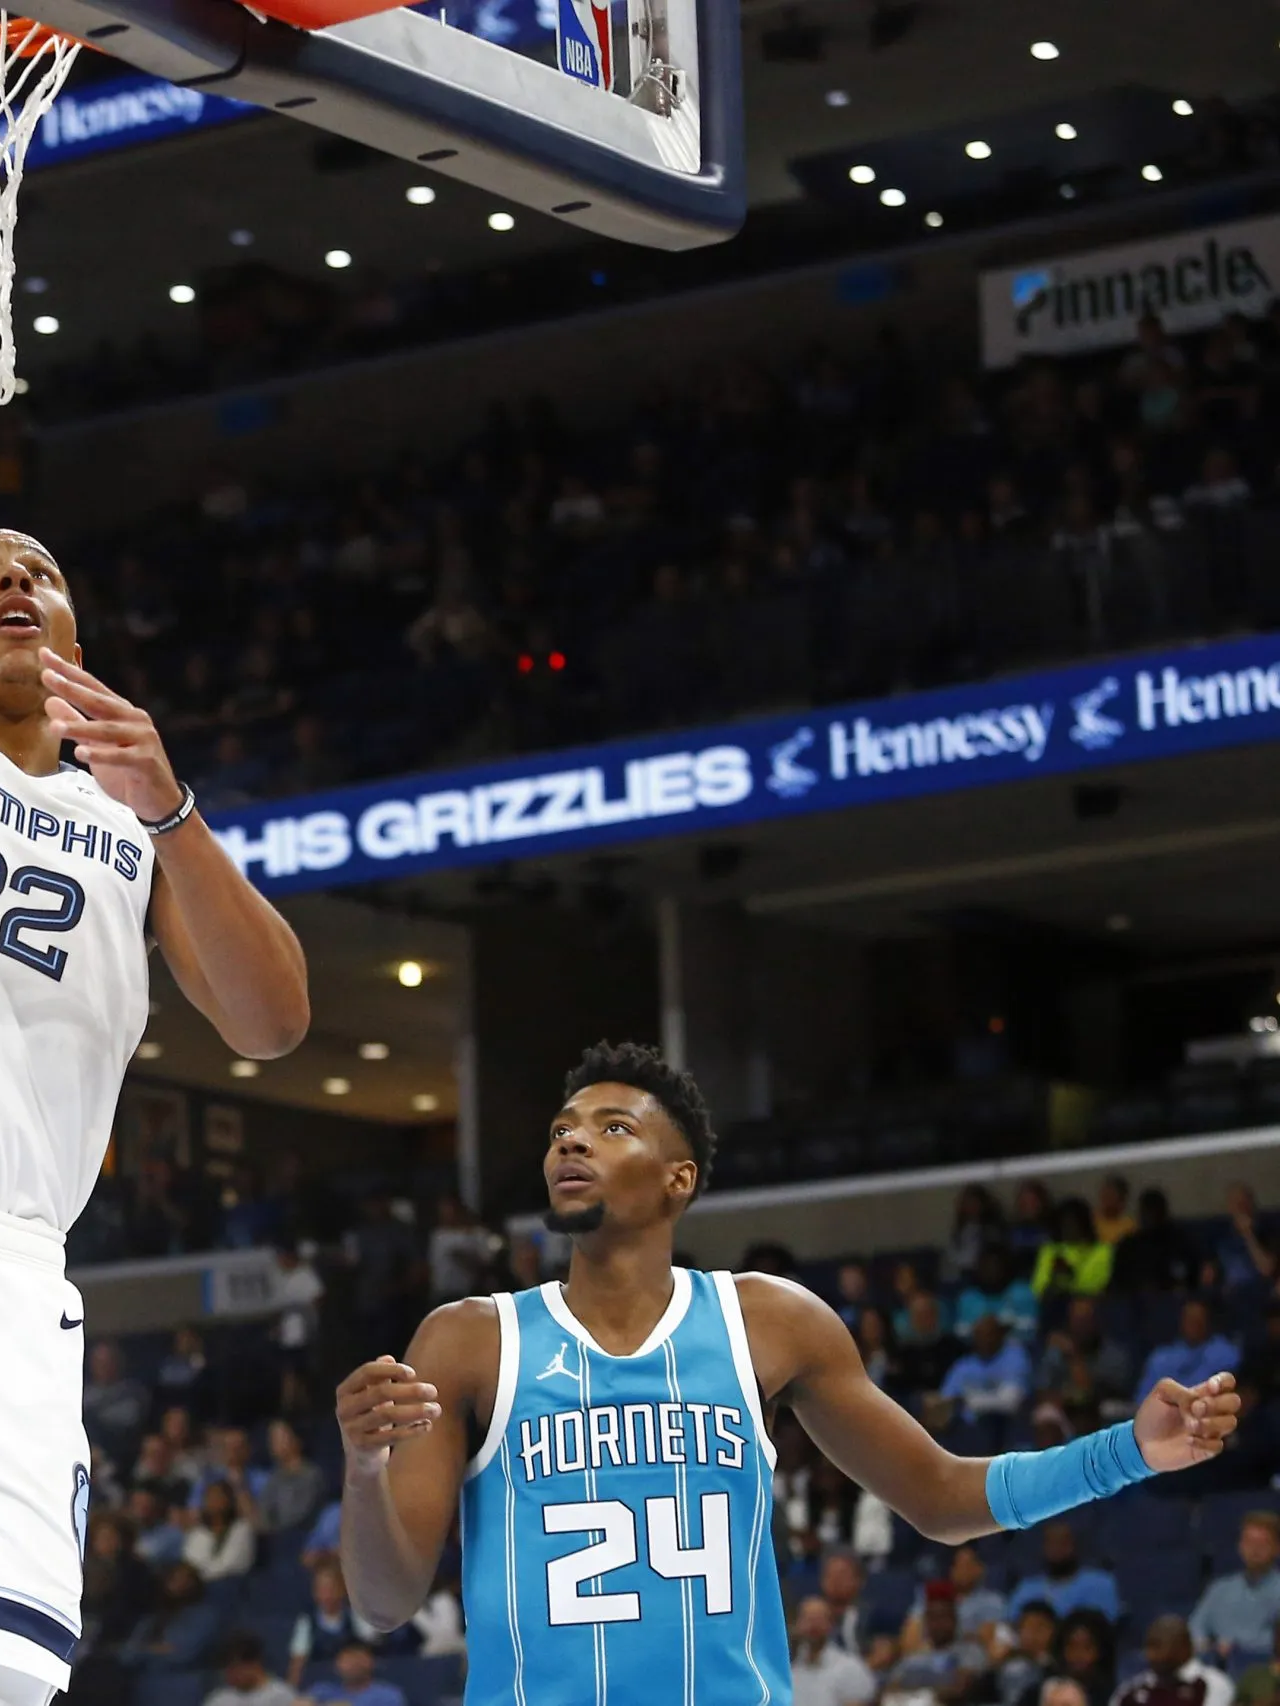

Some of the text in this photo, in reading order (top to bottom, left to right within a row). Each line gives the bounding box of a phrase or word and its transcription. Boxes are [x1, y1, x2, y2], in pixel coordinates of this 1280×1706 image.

[565, 36, 593, 79] NBA
[42, 81, 206, 147] Hennessy
[1012, 236, 1262, 338] Pinnacle
[829, 702, 1055, 780] Hennessy
[213, 744, 753, 878] HIS GRIZZLIES
[517, 1403, 749, 1483] HORNETS
[542, 1491, 733, 1627] 24
